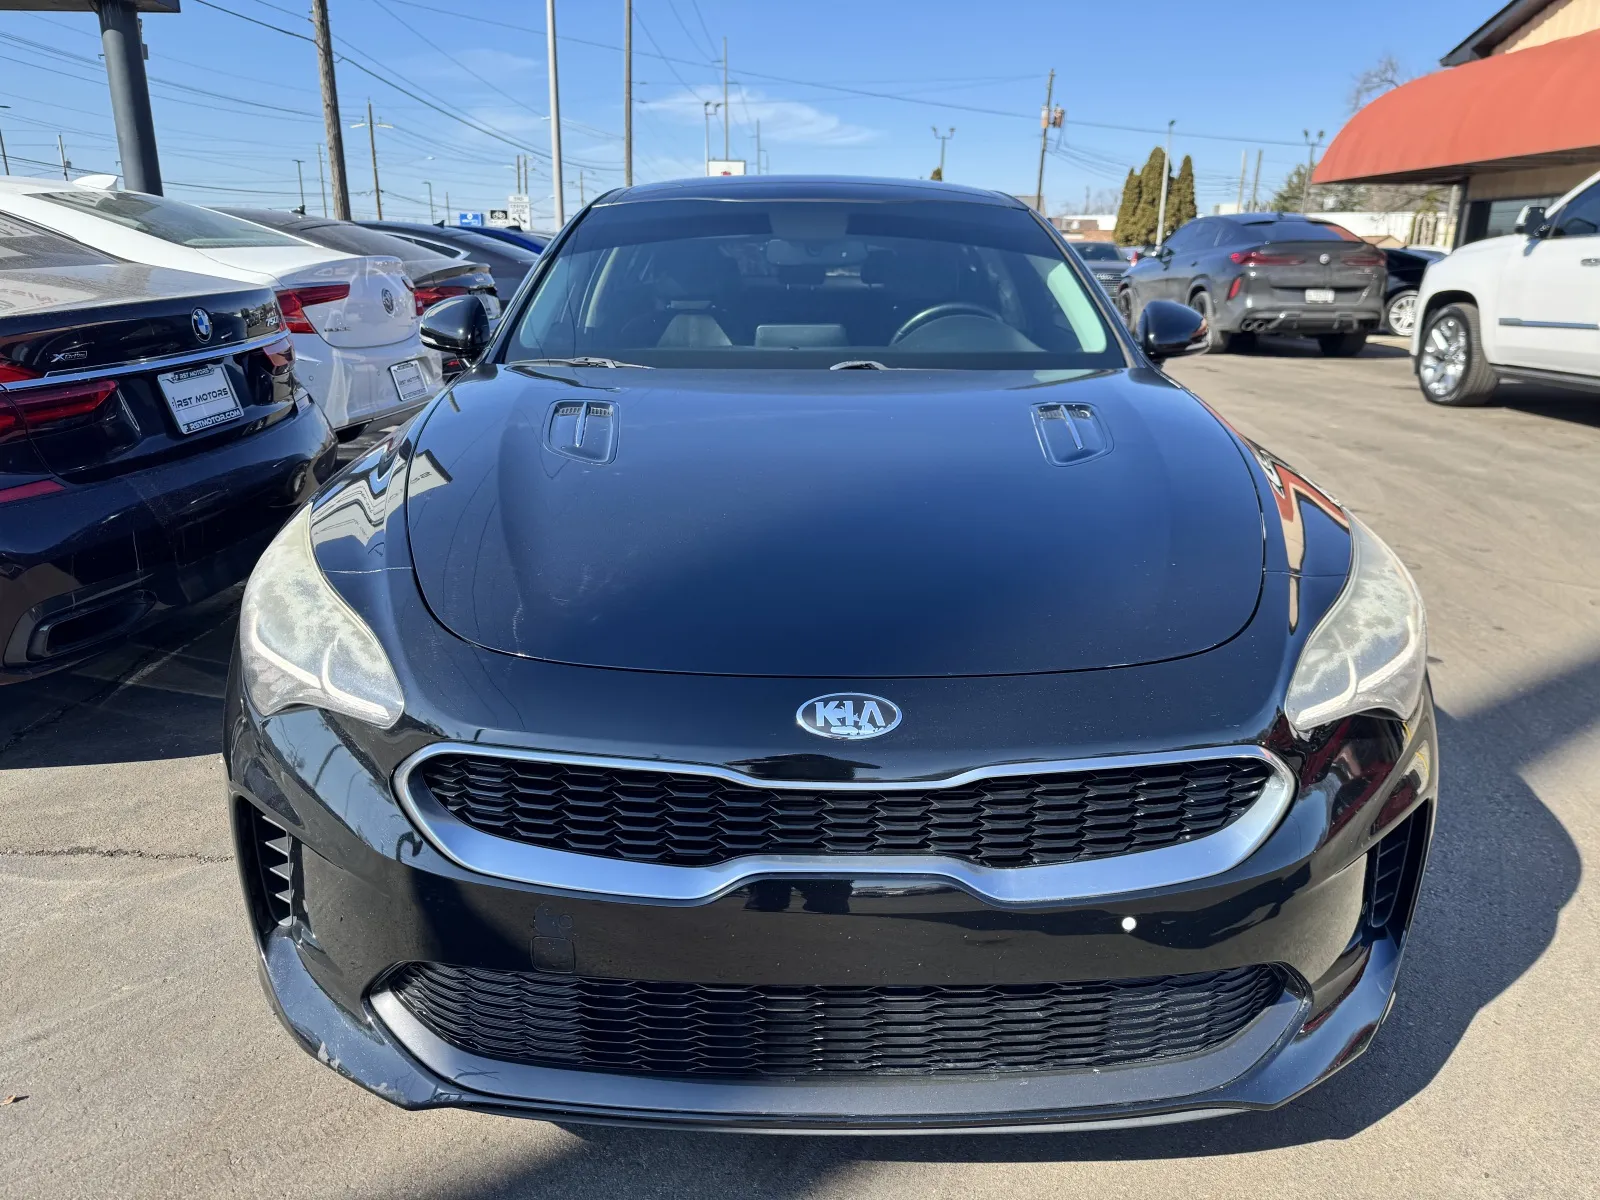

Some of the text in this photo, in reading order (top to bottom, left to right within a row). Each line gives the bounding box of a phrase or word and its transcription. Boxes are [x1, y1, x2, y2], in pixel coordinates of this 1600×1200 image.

[195, 387, 228, 403] MOTORS
[184, 409, 240, 432] FRSTMOTOR.COM
[814, 700, 886, 727] KIA
